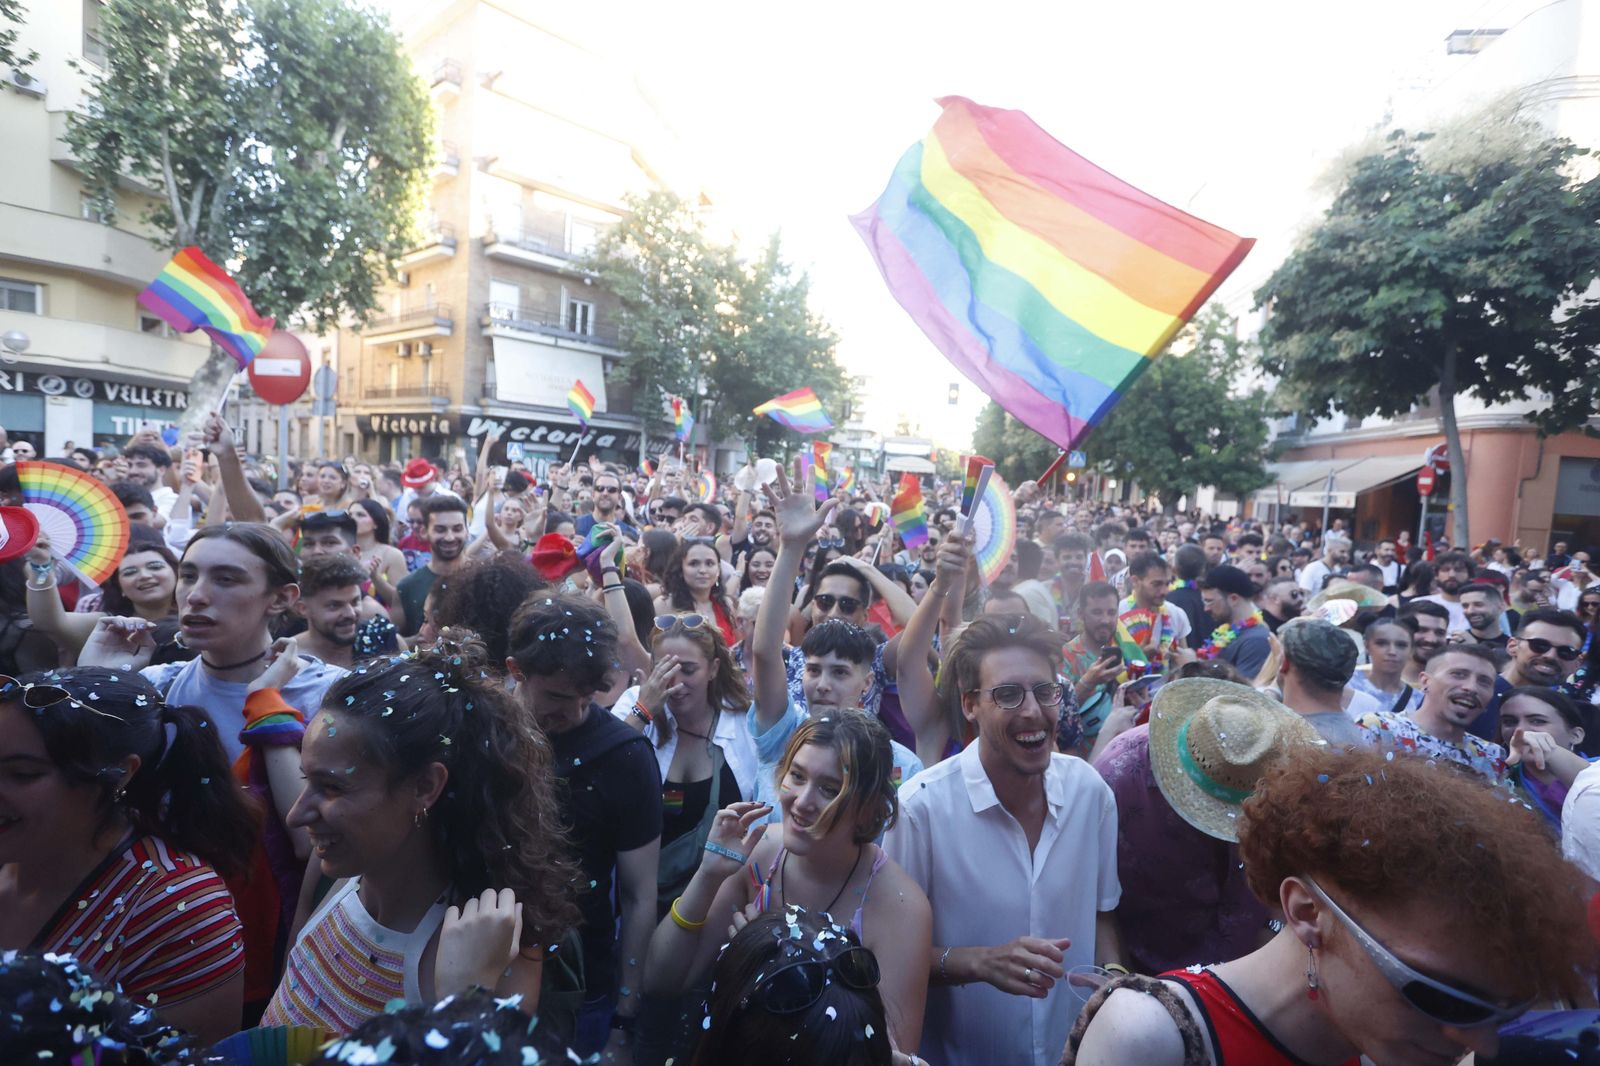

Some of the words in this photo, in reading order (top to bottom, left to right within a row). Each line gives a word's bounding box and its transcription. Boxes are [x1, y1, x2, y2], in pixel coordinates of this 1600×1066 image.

[370, 414, 450, 435] Victoria
[467, 417, 616, 448] Victoria
[624, 434, 674, 454] Vitoria
